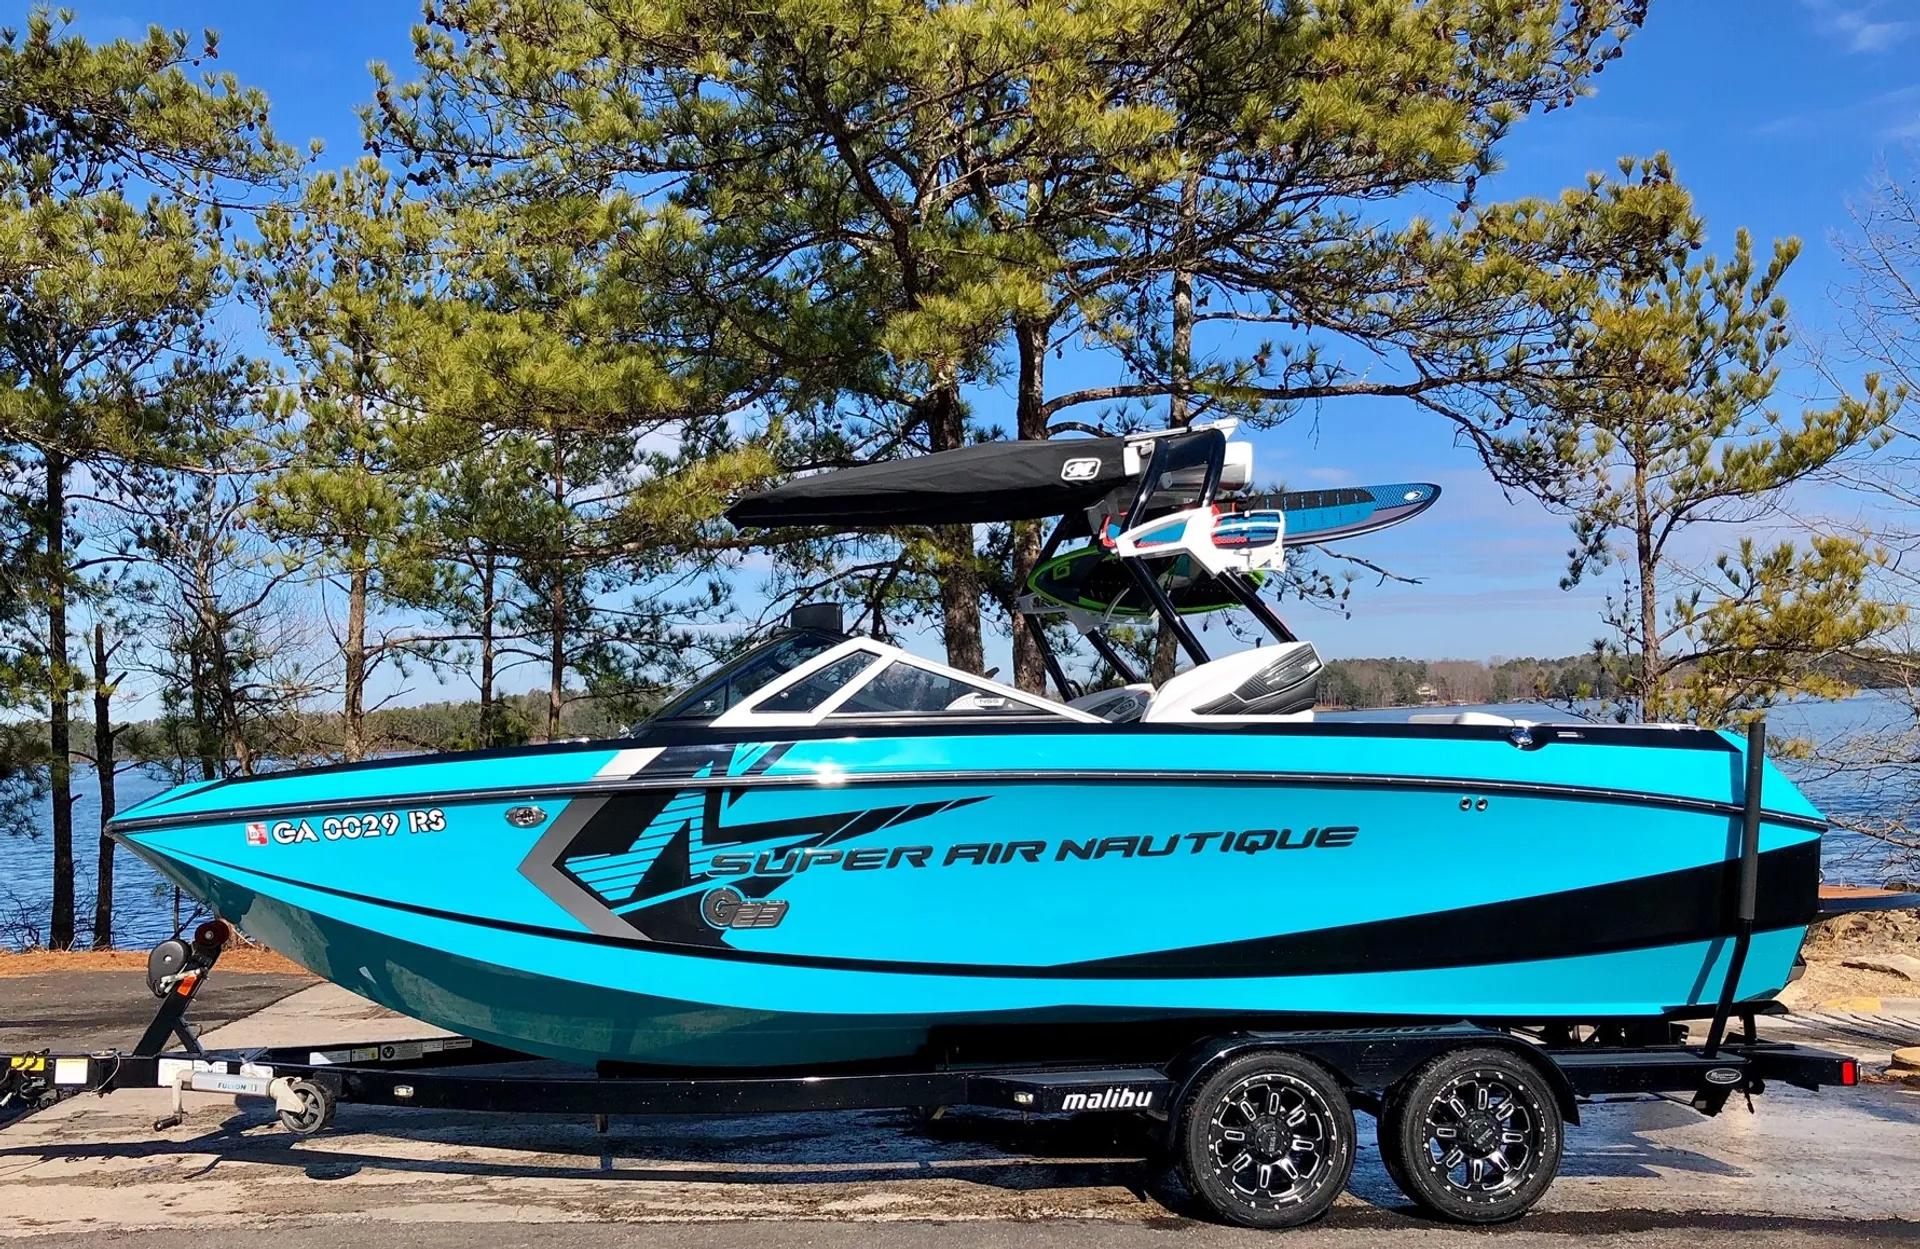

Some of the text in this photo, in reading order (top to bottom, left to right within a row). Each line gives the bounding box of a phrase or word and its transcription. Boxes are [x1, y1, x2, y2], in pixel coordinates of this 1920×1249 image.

[272, 808, 447, 845] GA 0029 RS
[706, 826, 1360, 877] SUPER AIR NAUTIQUE
[702, 887, 790, 929] G23
[1061, 1088, 1153, 1110] malibu
